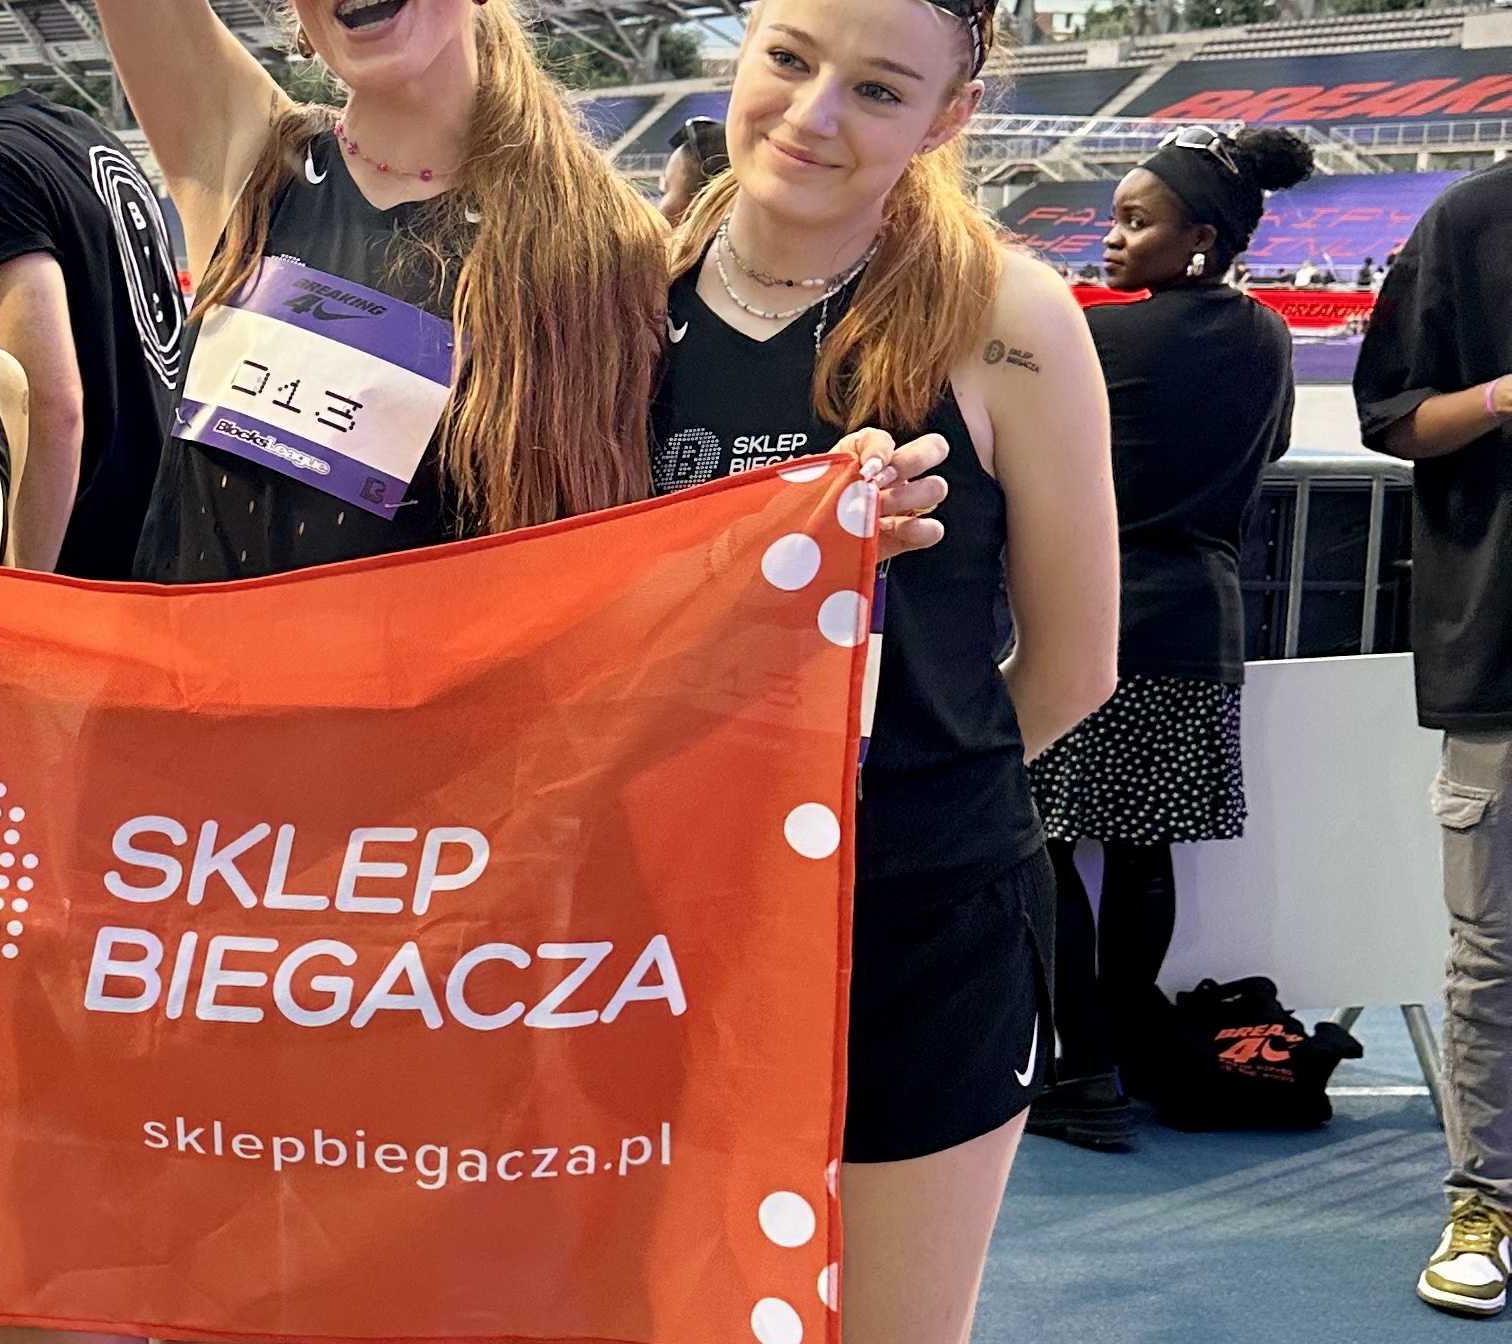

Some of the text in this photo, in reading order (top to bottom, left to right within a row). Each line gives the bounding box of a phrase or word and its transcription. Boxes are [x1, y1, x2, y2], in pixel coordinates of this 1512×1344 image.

[283, 293, 324, 315] 4
[292, 277, 388, 316] BREAKING
[231, 359, 363, 433] 013
[731, 433, 808, 455] SKLEP
[103, 815, 490, 916] SKLEP
[83, 926, 688, 1032] BIEGACZA
[142, 1116, 673, 1190] sklepbiegacza.pl
